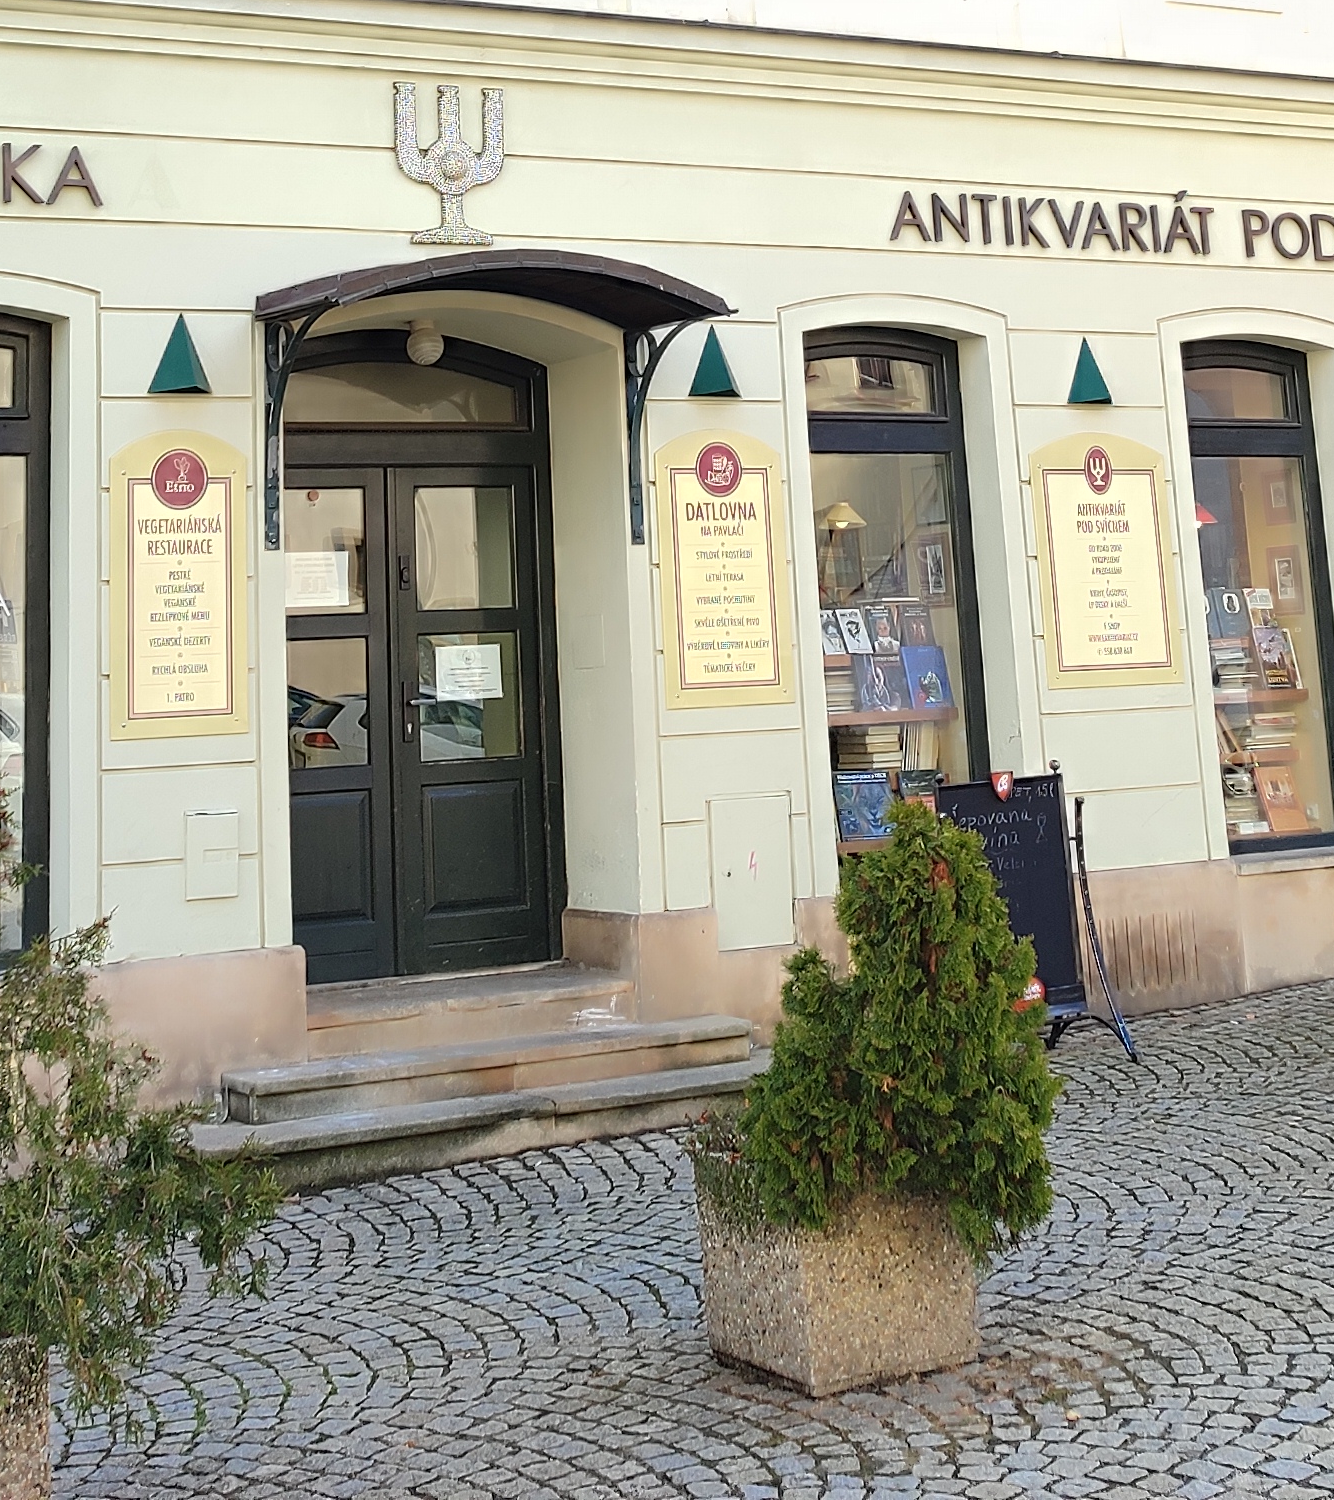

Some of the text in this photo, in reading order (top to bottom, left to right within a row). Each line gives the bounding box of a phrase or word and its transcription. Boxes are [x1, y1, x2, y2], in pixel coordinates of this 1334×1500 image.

[890, 190, 1214, 255] ANTIKVARIÁT
[686, 501, 757, 521] DATLOVNA
[1077, 500, 1125, 517] ANTIKVARIÁT
[137, 513, 222, 535] VEGETARIÁNSKÁ
[701, 526, 712, 536] NA
[1076, 518, 1130, 533] POD SVÍCNEM
[147, 538, 213, 556] RESTAURACE
